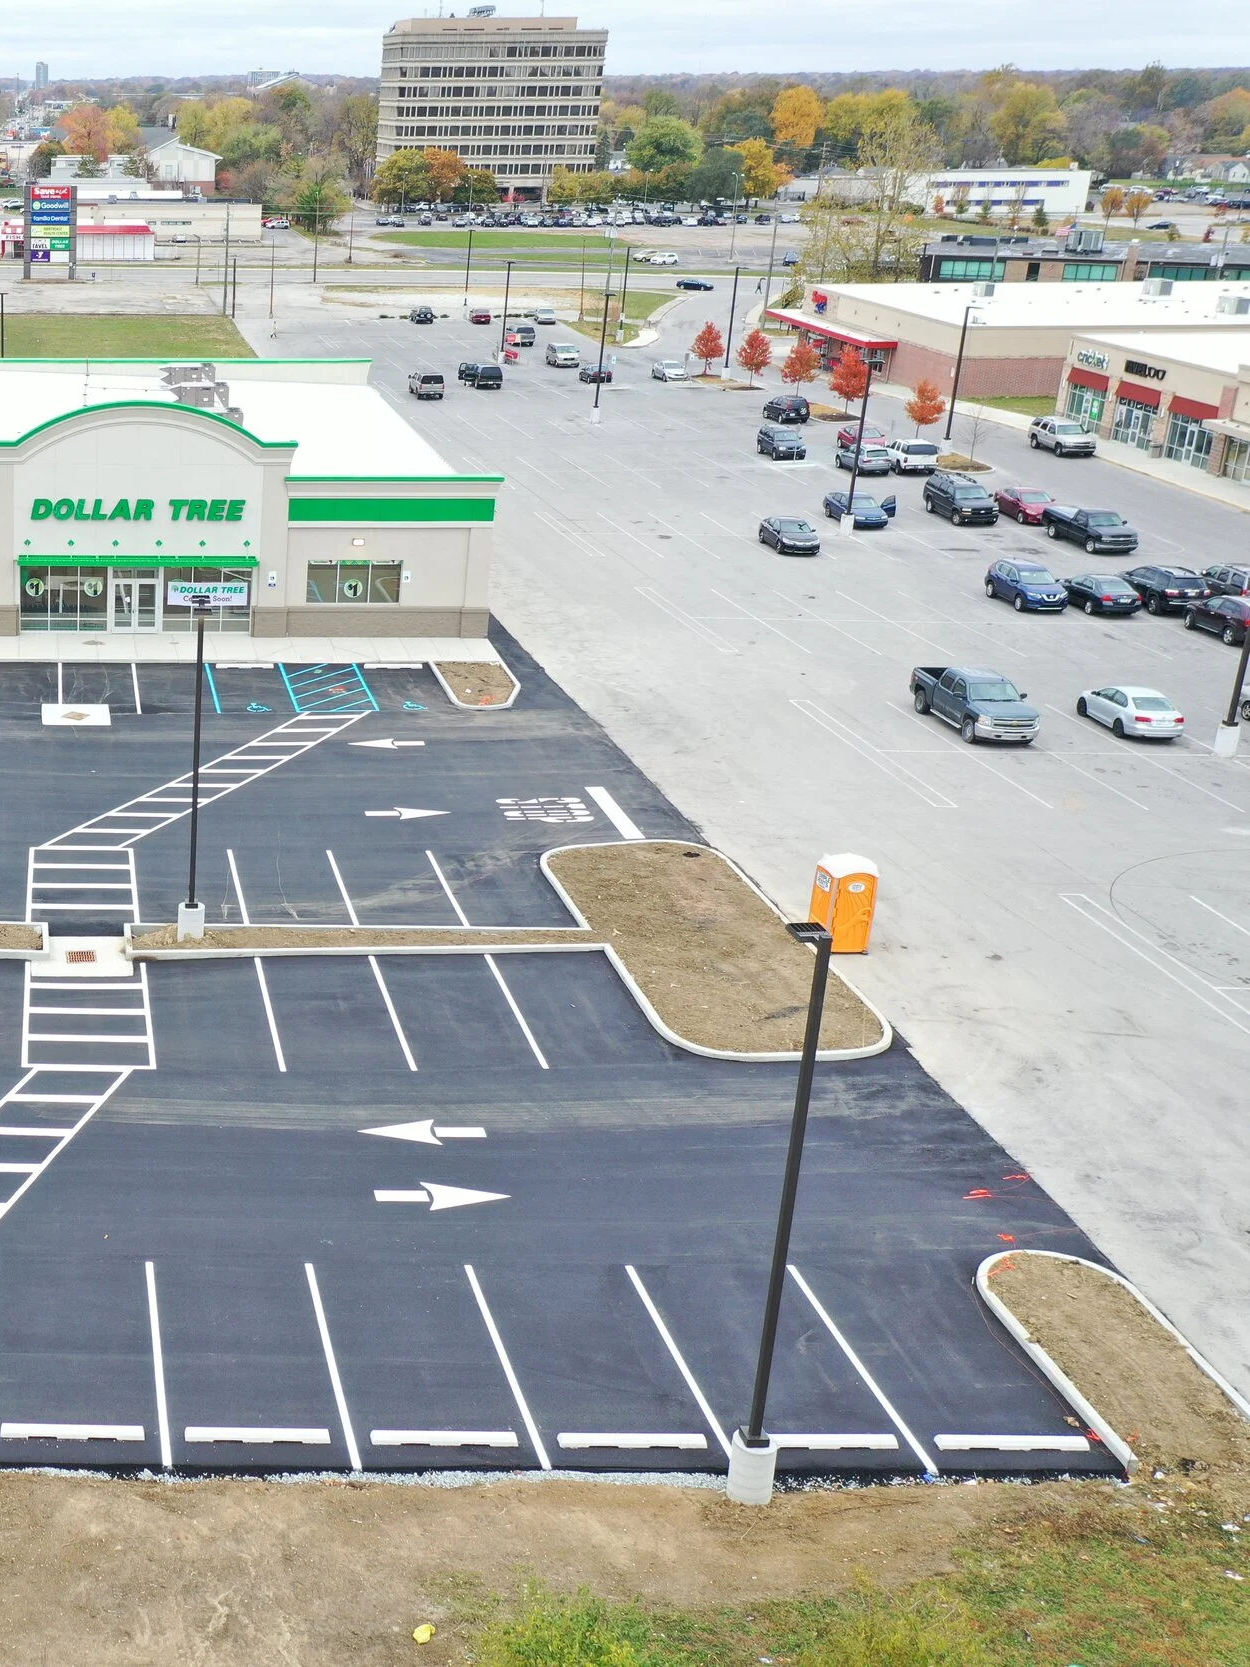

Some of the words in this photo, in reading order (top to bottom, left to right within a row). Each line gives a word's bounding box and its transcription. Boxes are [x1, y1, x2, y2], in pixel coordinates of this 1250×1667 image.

[34, 187, 55, 195] Save
[30, 498, 154, 521] DOLLAR
[169, 499, 246, 521] TREE
[180, 586, 218, 594] DOLLAR
[221, 586, 244, 594] TREE
[348, 583, 358, 597] $1
